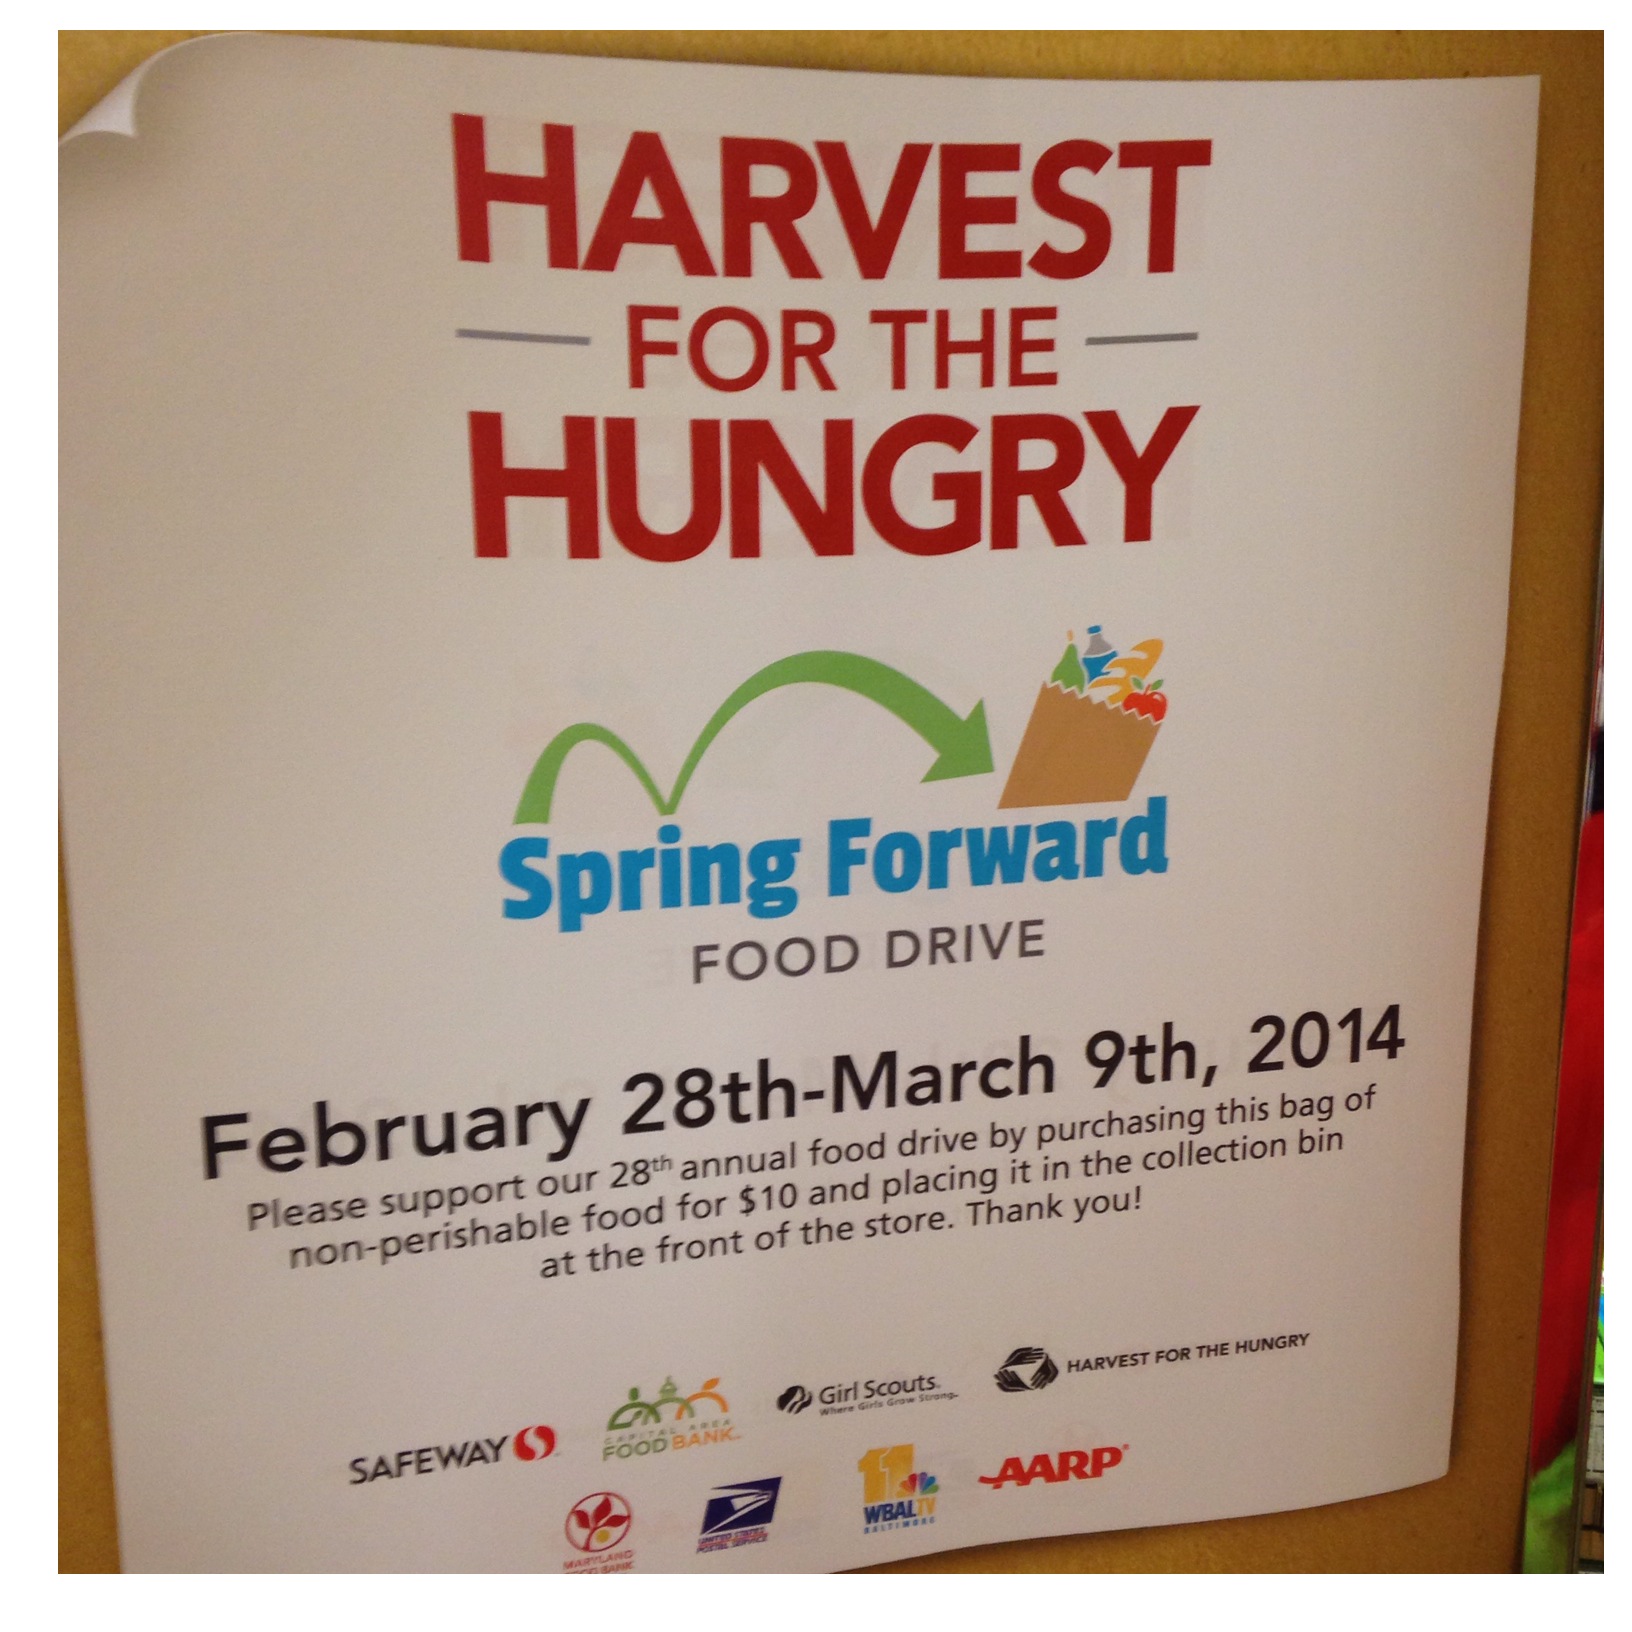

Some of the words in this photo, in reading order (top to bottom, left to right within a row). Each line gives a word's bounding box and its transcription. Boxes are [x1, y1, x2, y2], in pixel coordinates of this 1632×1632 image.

[451, 112, 1213, 280] HARVEST
[628, 304, 837, 392] FOR
[870, 306, 1059, 390] THE
[468, 404, 1202, 563] HUNGRY
[500, 824, 801, 933] Spring
[828, 795, 1169, 898] Forward
[692, 934, 860, 985] FOOD
[886, 918, 1046, 969] DRIVE
[201, 1097, 592, 1181] February
[621, 1034, 1056, 1135] 28th-March
[1085, 1021, 1219, 1090] 9th,
[1247, 1004, 1406, 1074] 2014
[247, 1196, 367, 1232] Please
[379, 1174, 526, 1217] support
[536, 1169, 600, 1197] our
[609, 1154, 673, 1190] 28th
[680, 1141, 798, 1181] annual
[808, 1132, 887, 1167] food
[897, 1129, 978, 1158] drive
[989, 1122, 1027, 1153] by
[1036, 1105, 1206, 1151] purchasing
[1216, 1097, 1270, 1126] this
[1279, 1092, 1335, 1121] bag
[1344, 1083, 1378, 1112] of
[289, 1208, 571, 1270] non-perishable
[581, 1196, 665, 1232] food
[676, 1191, 727, 1222] for
[739, 1181, 798, 1217] $10
[808, 1172, 870, 1206] and
[881, 1164, 998, 1204] placing
[1010, 1158, 1031, 1185] it
[1042, 1154, 1070, 1182] in
[1081, 1149, 1132, 1179] the
[1142, 1134, 1287, 1171] collection
[1297, 1126, 1345, 1156] bin
[539, 1251, 577, 1279] at
[586, 1242, 644, 1272] the
[655, 1232, 745, 1264] front
[754, 1220, 791, 1251] of
[799, 1216, 855, 1246] the
[864, 1210, 955, 1239] store.
[964, 1193, 1064, 1227] Thank
[1073, 1185, 1142, 1224] you!
[1067, 1351, 1151, 1376] HARVEST
[1155, 1346, 1192, 1365] FOR
[1196, 1341, 1230, 1360] THE
[1234, 1332, 1311, 1356] HUNGRY
[818, 1380, 859, 1405] Girl
[818, 1404, 855, 1417] Where
[857, 1400, 884, 1411] Girls
[886, 1396, 916, 1408] Grow
[349, 1435, 510, 1486] SAFEWAY
[602, 1437, 668, 1462] FOOD
[672, 1427, 736, 1451] BANK
[603, 1427, 676, 1446] CAPITAL
[688, 1418, 731, 1432] AREA
[979, 1445, 1123, 1489] AARP
[863, 1516, 936, 1535] BALTIMORE
[562, 1549, 634, 1570] MARYLAND
